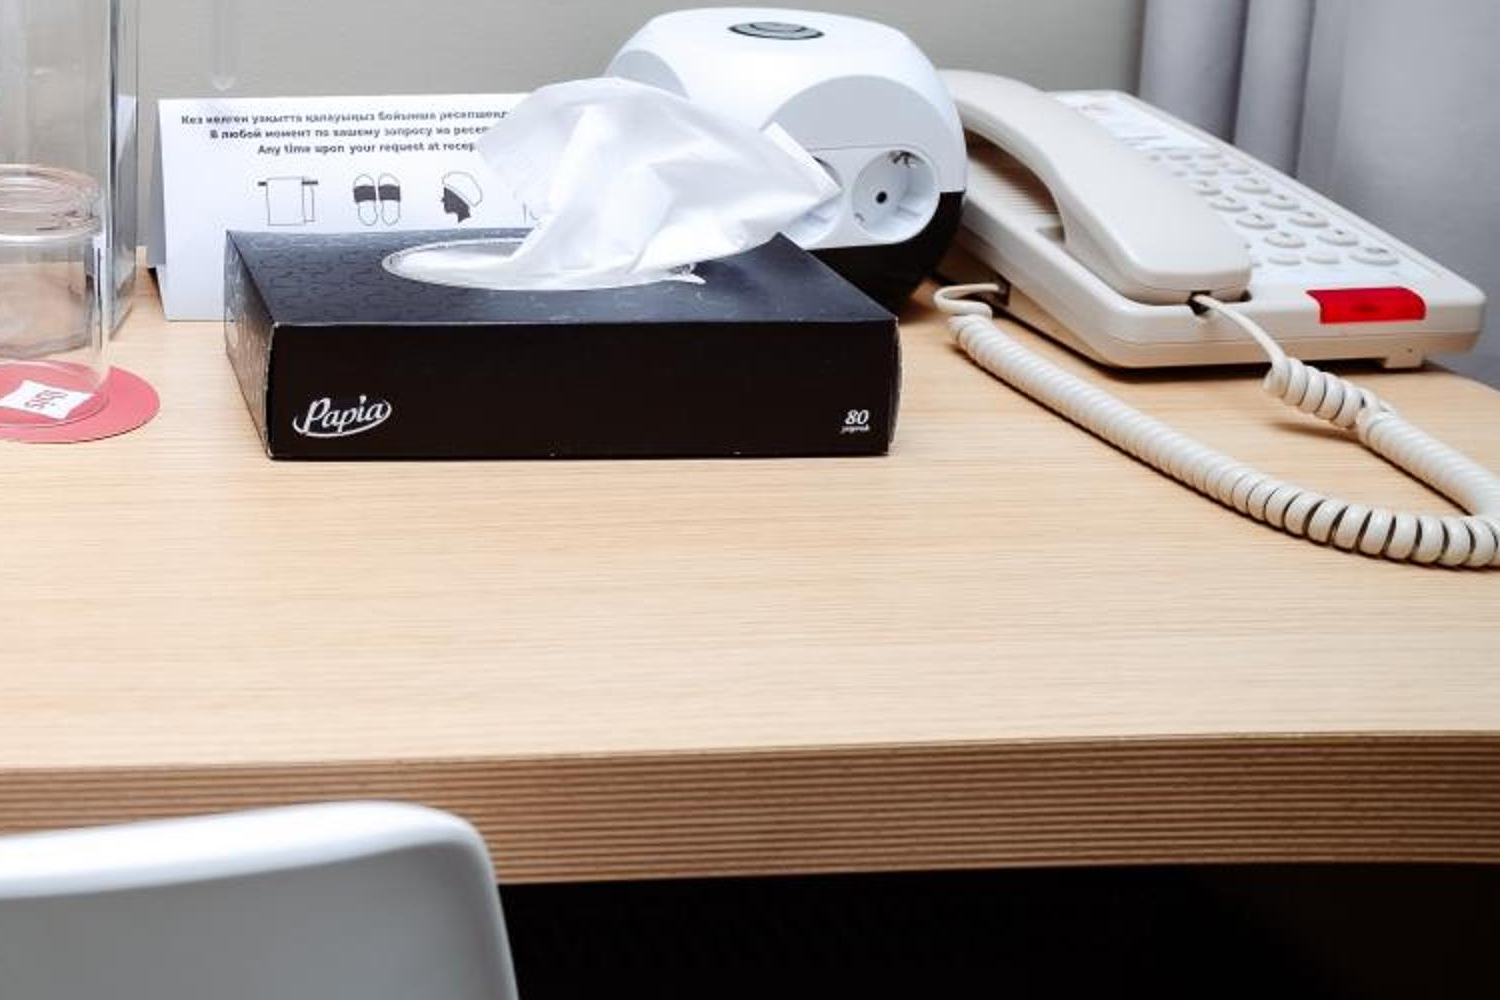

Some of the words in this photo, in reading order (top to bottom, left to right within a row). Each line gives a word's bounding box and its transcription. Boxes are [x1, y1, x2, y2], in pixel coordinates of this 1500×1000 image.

[181, 115, 203, 124] Кез
[210, 129, 219, 139] В
[221, 128, 261, 139] любой
[265, 129, 311, 138] момент
[315, 128, 329, 137] по
[333, 128, 381, 138] вашему
[384, 126, 432, 137] запросу
[257, 144, 280, 156] Any
[283, 143, 311, 154] time
[314, 144, 345, 155] upon
[349, 143, 375, 155] your
[379, 142, 425, 154] request
[428, 142, 440, 151] at
[302, 394, 387, 434] Papia
[844, 409, 869, 425] 80
